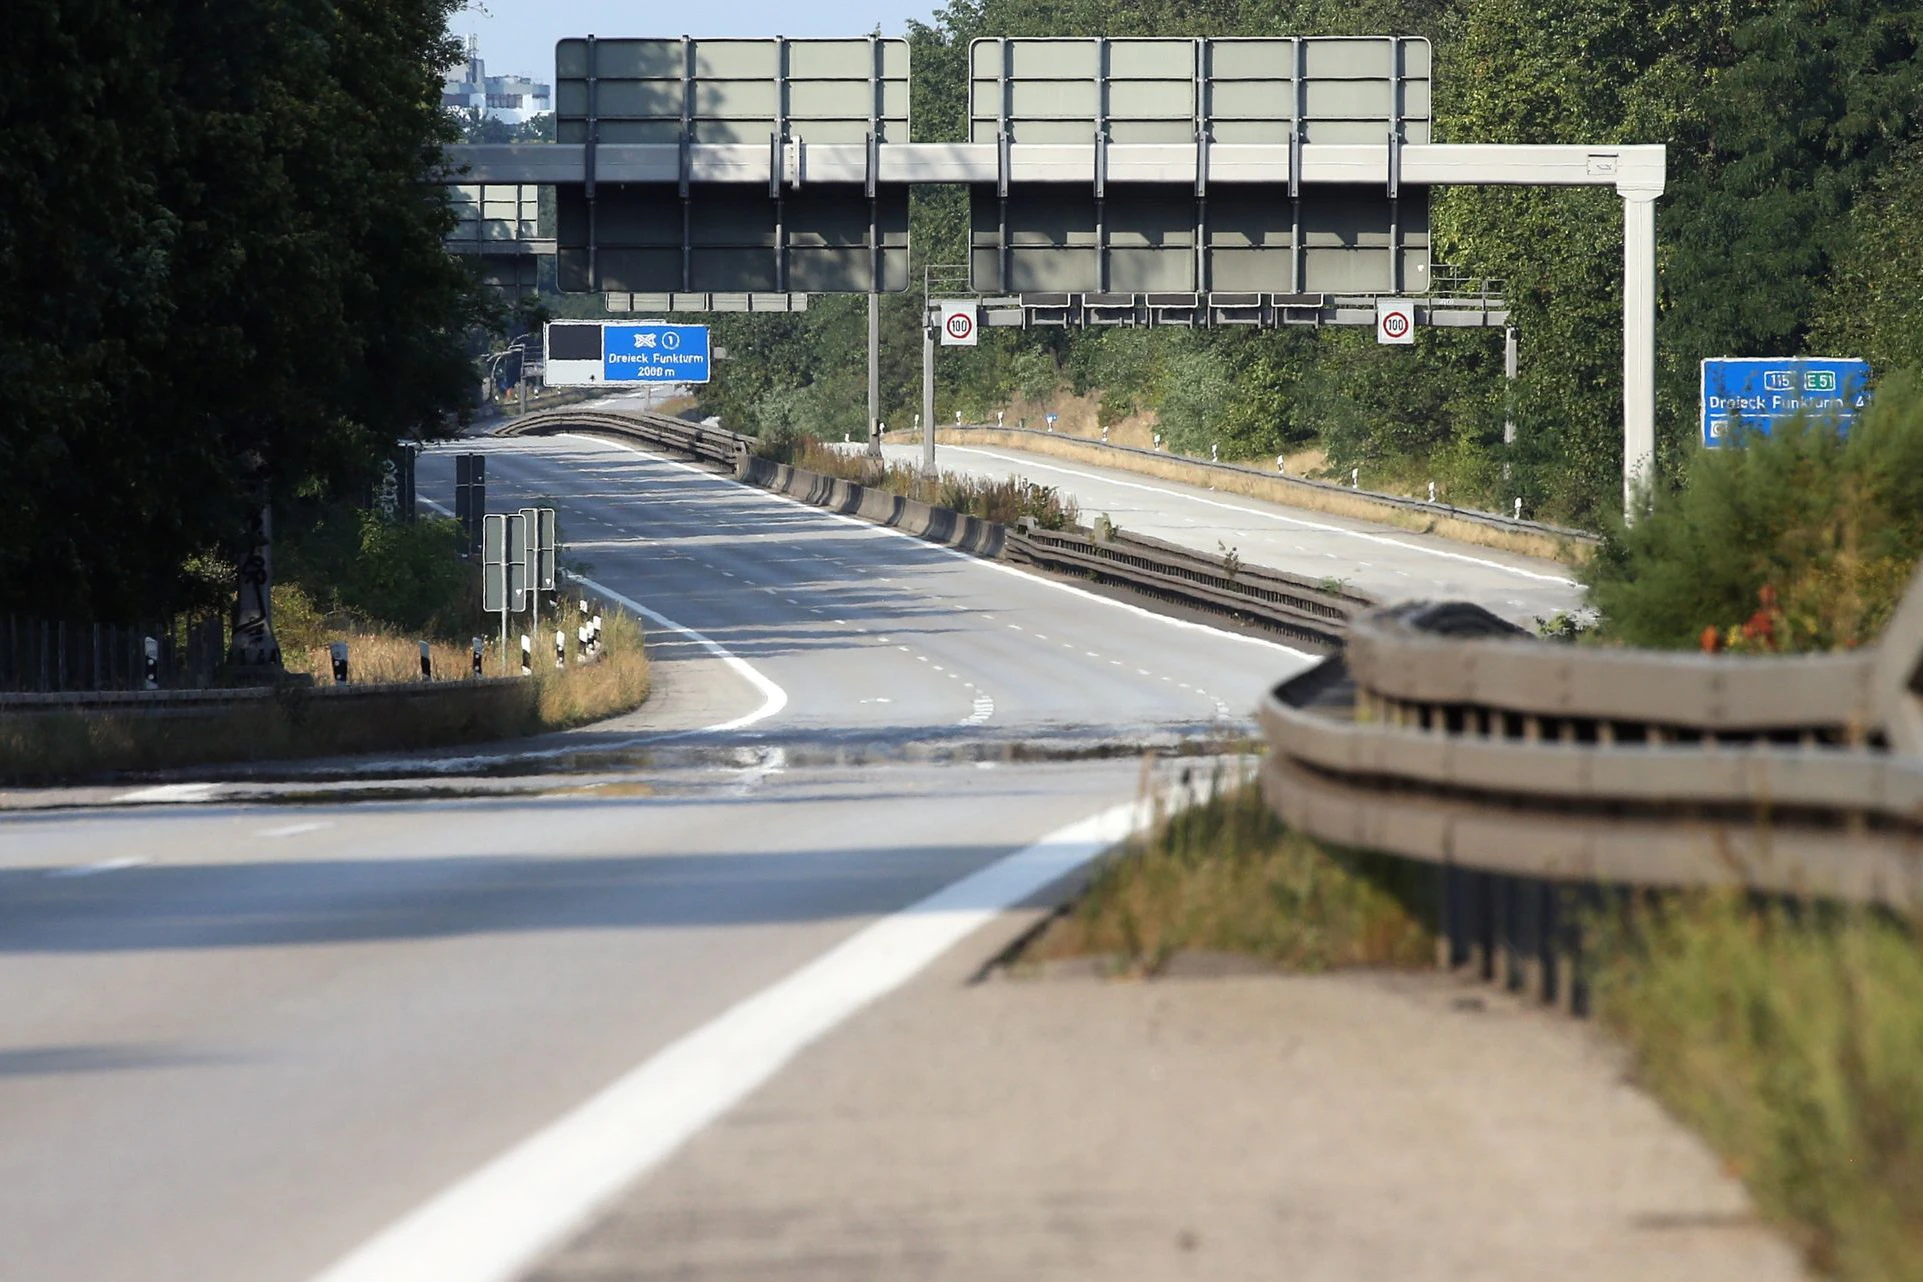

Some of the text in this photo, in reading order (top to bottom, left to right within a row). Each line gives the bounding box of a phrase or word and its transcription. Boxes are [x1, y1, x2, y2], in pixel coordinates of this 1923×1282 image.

[952, 320, 967, 332] 100
[1388, 319, 1404, 331] 100
[608, 353, 704, 365] Dreieck Funkturm
